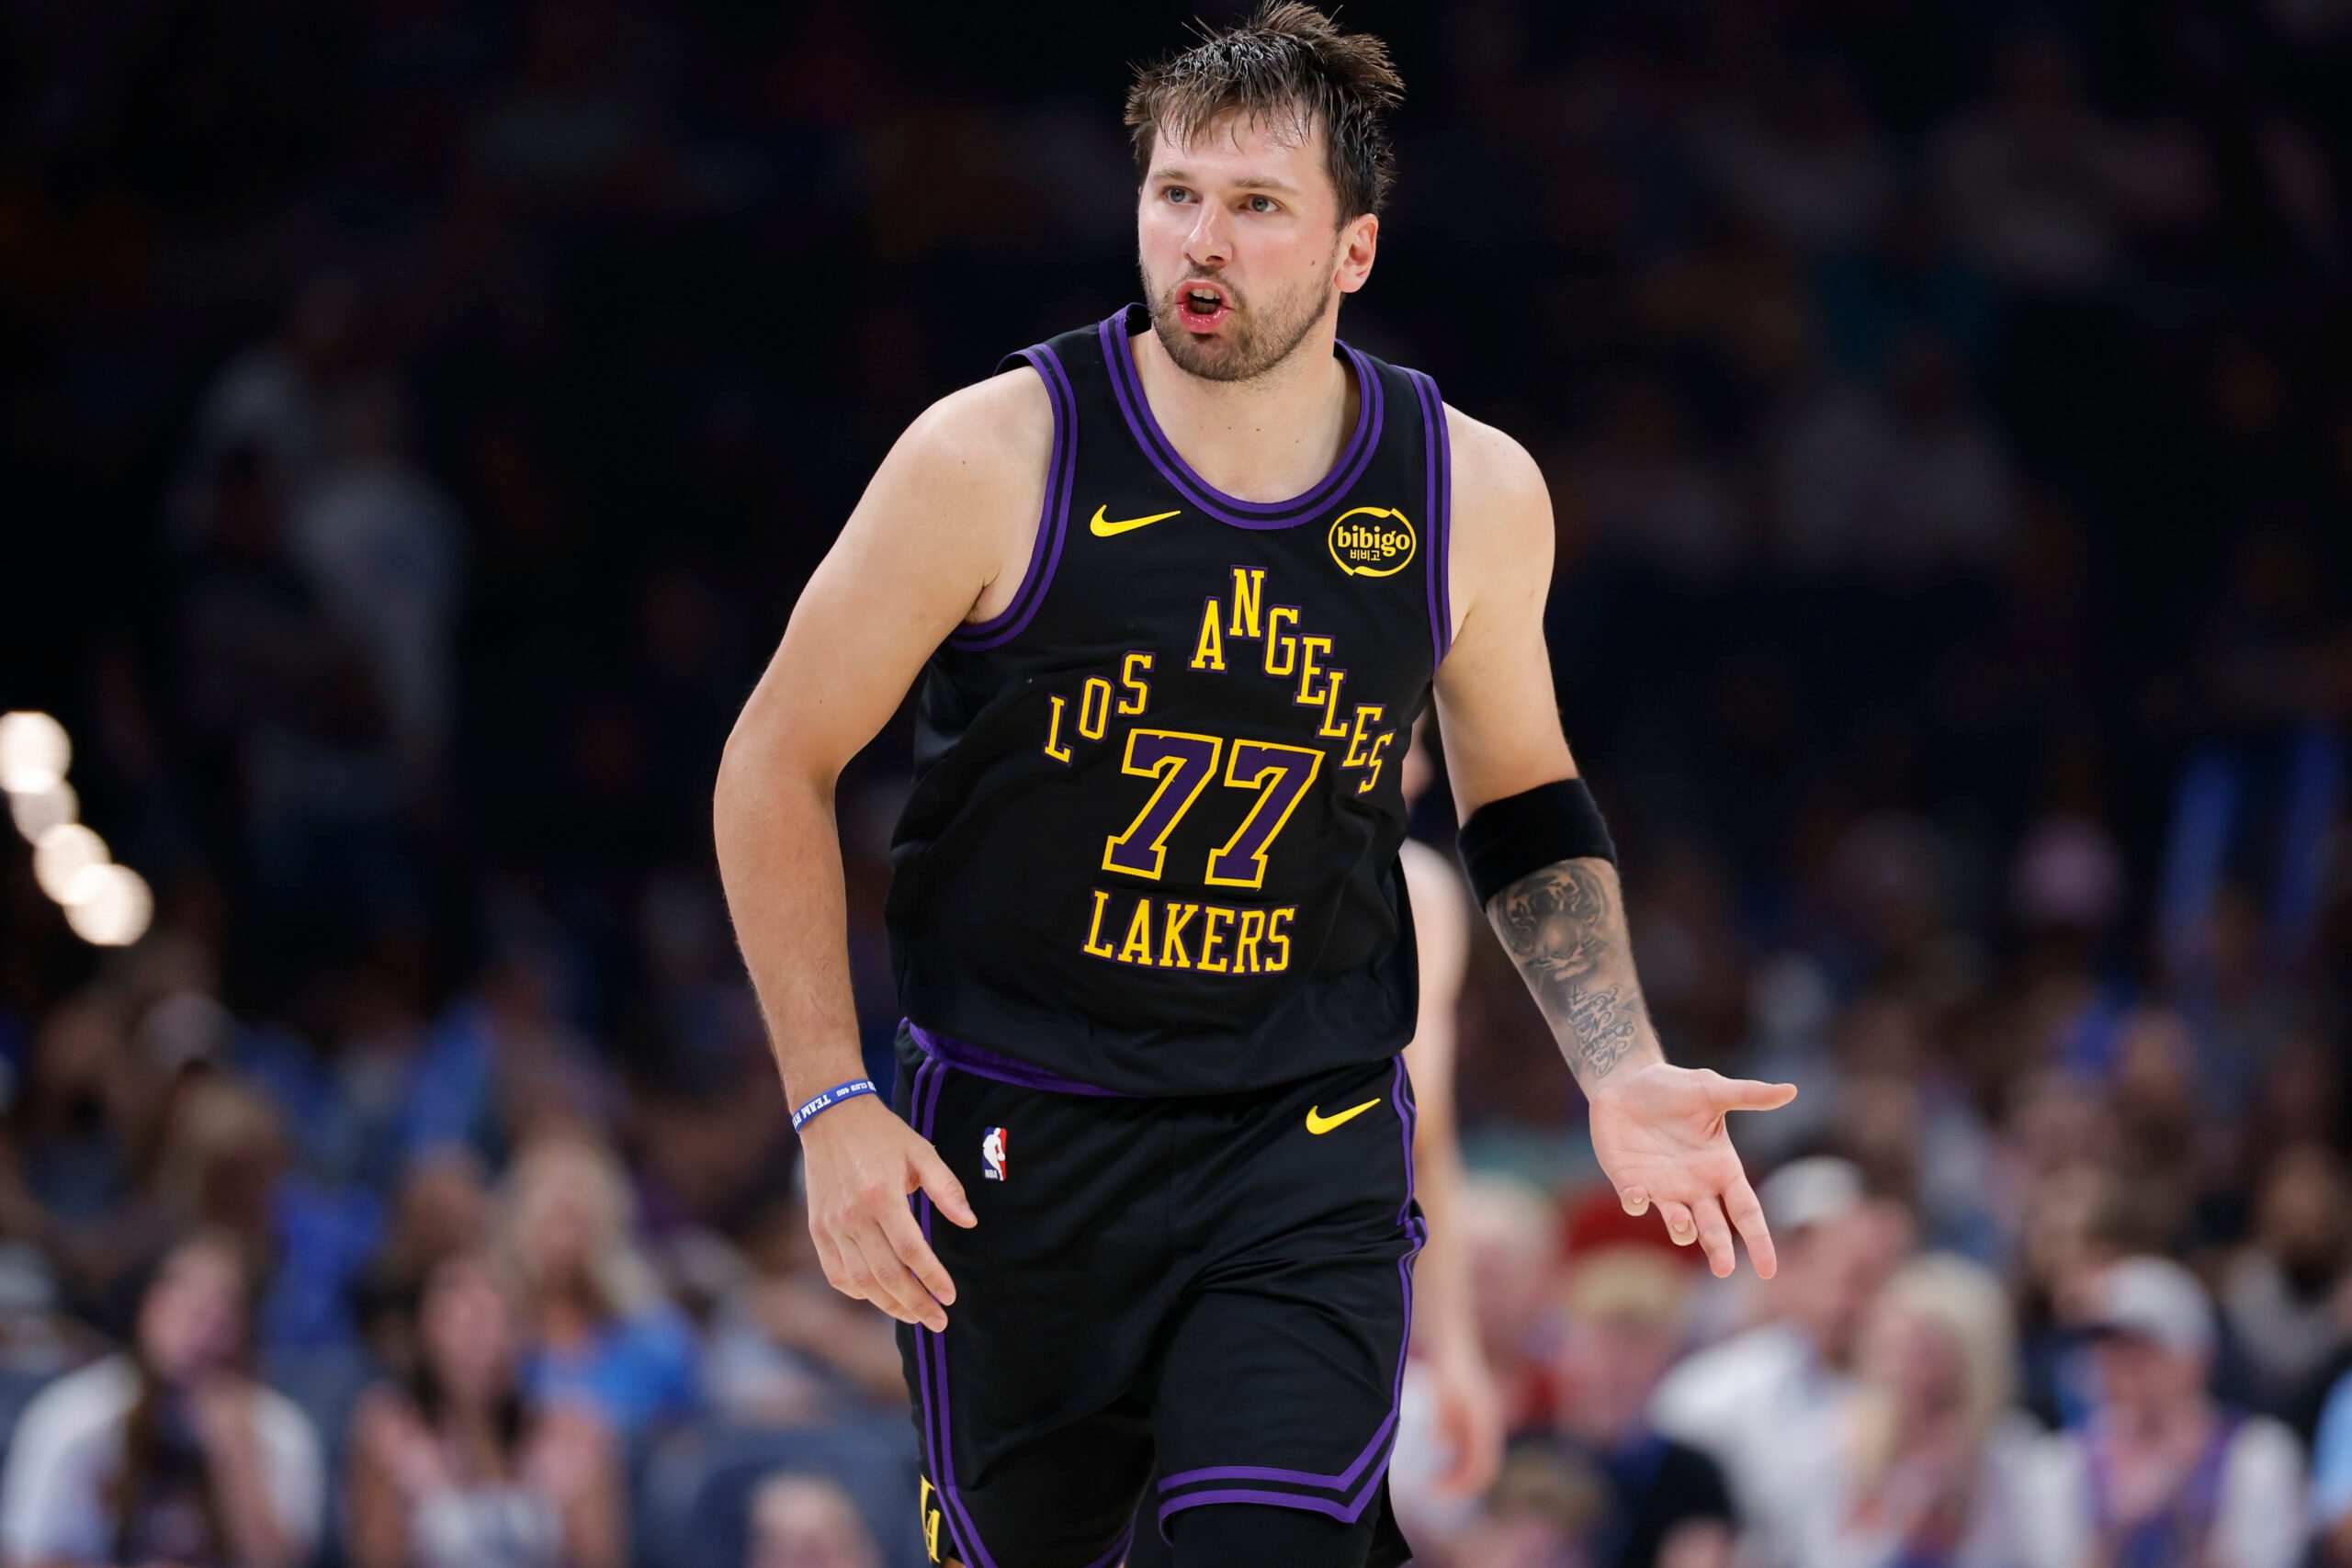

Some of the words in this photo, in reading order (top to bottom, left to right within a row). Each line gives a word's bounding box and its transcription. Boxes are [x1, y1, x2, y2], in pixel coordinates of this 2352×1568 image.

[1337, 525, 1410, 557] bibigo
[1350, 549, 1380, 561] 비비고
[1042, 650, 1154, 767] LOS
[1187, 565, 1396, 796] ANGELES
[1102, 728, 1326, 890] 77
[1081, 889, 1299, 975] LAKERS
[801, 1094, 831, 1118] TEAM
[985, 1169, 998, 1179] NBA
